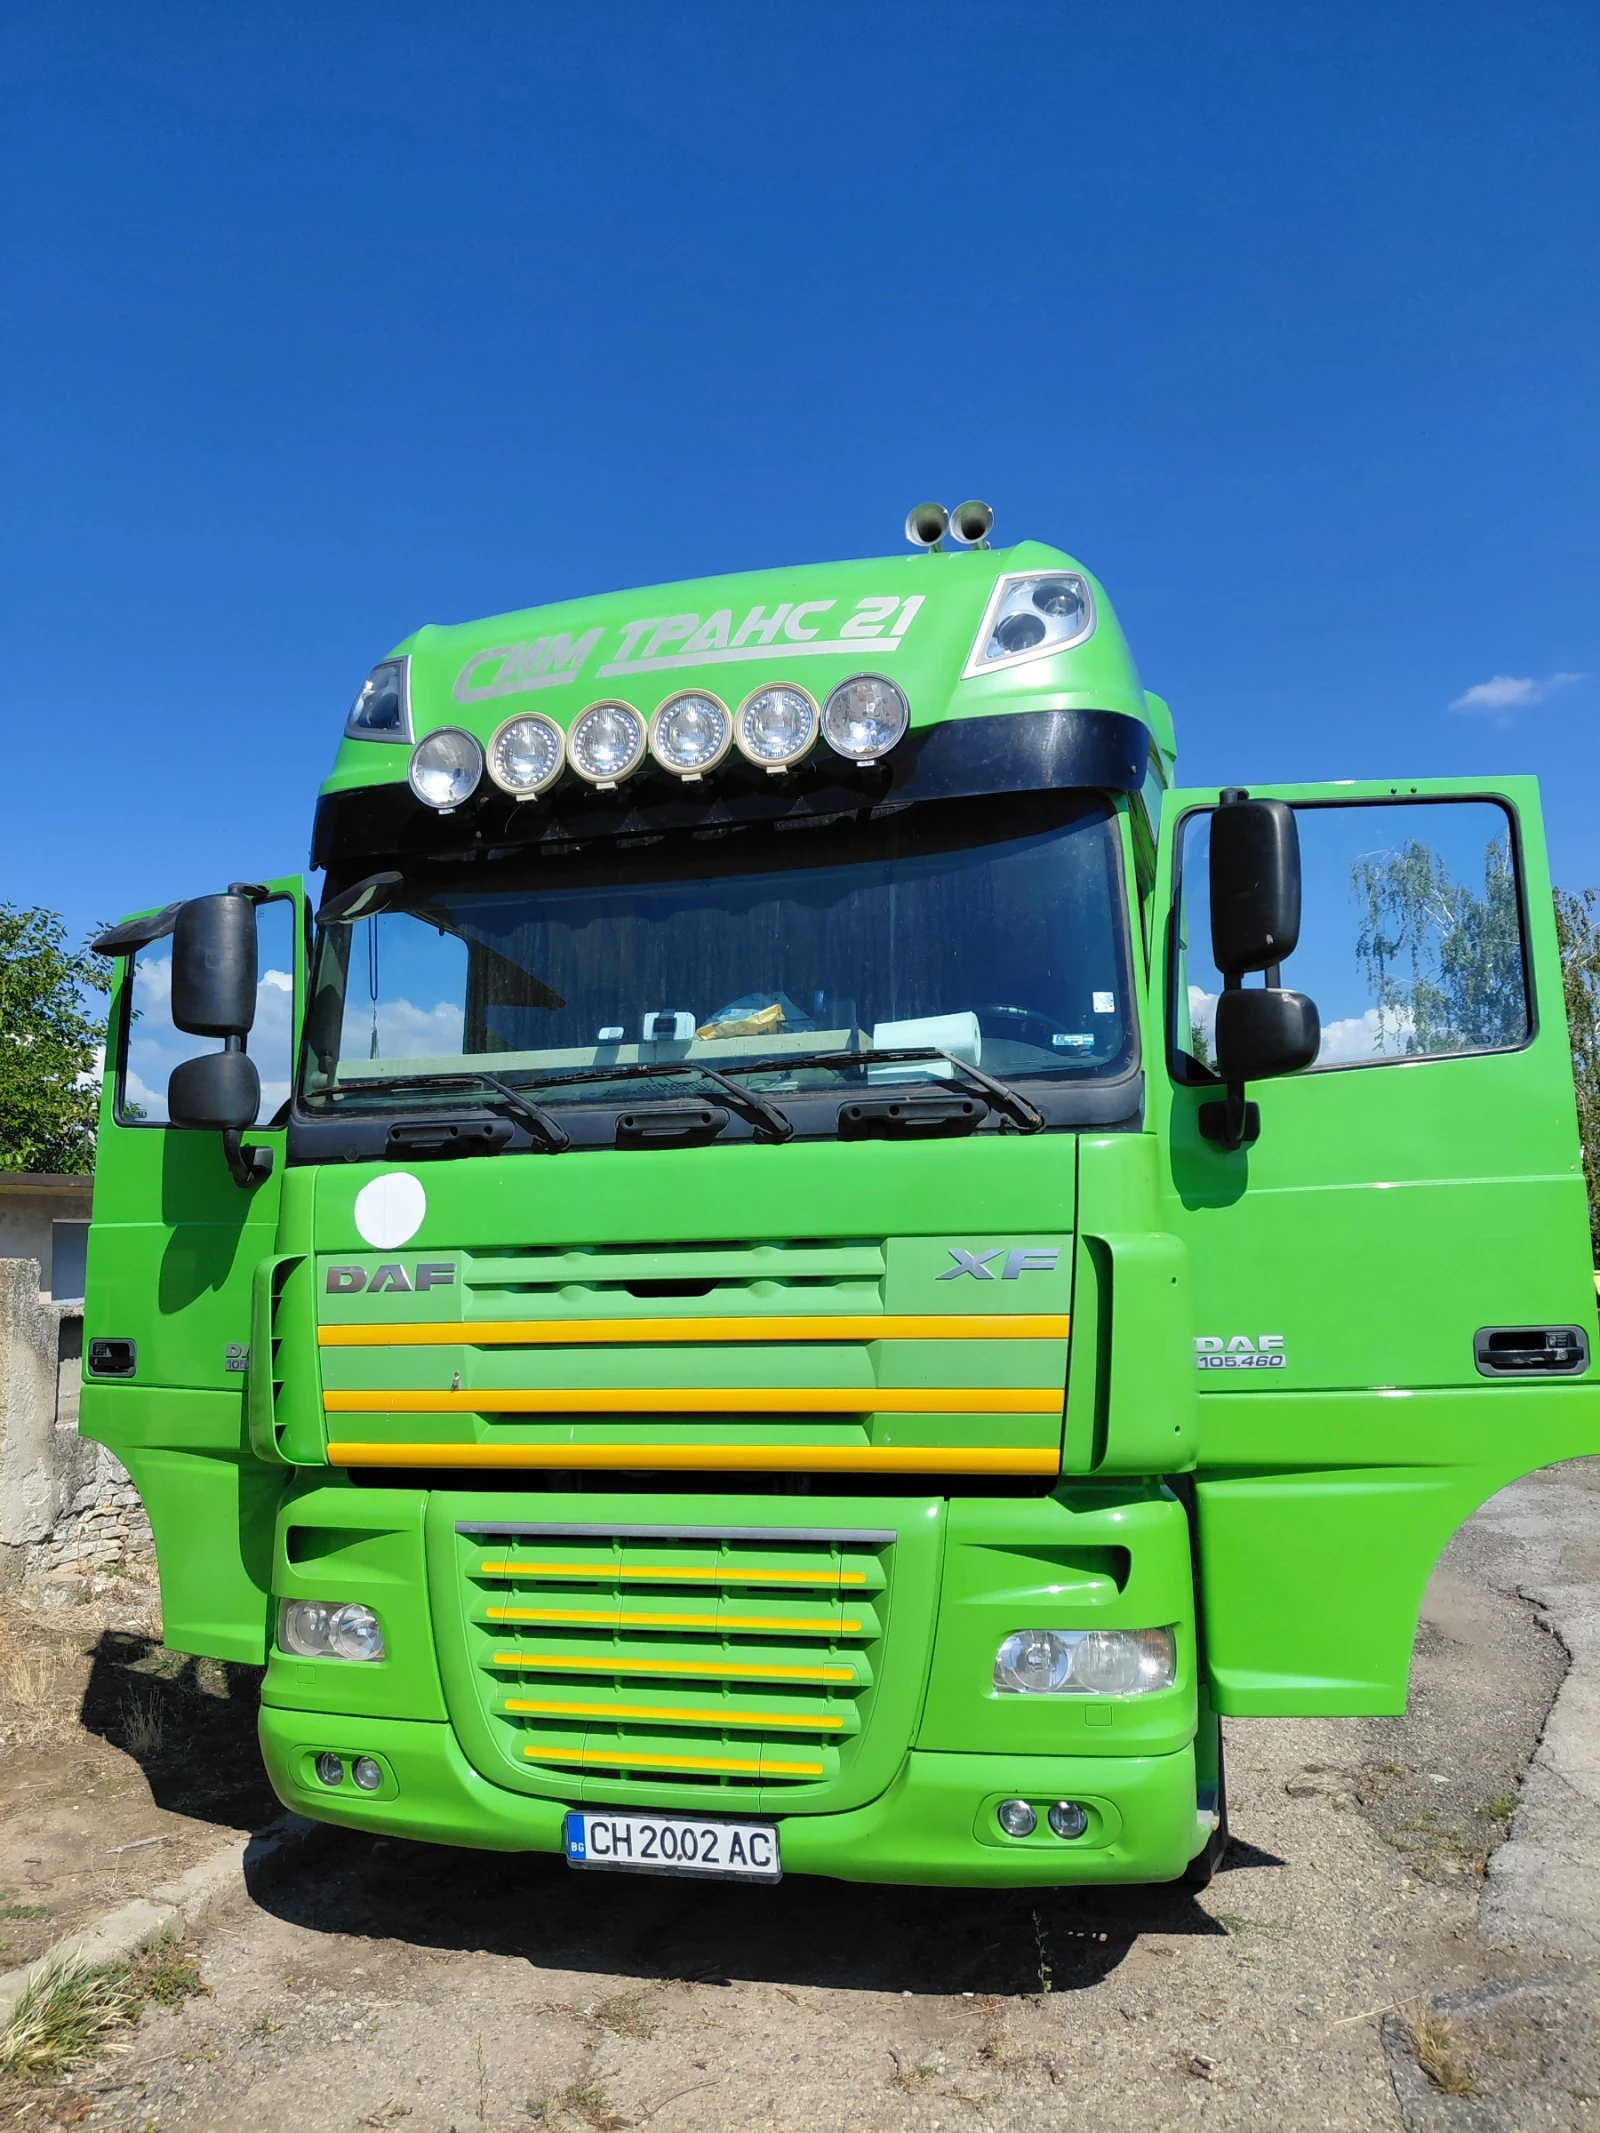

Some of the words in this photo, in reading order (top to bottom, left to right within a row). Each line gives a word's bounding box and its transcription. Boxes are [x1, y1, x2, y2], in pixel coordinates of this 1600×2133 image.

[453, 627, 603, 703] СИМ
[613, 600, 837, 660] ТРАНС
[840, 595, 926, 637] 21
[326, 1263, 455, 1294] DAF
[935, 1249, 1060, 1280] XF
[1193, 1335, 1284, 1353] DAF
[1198, 1355, 1283, 1368] 105.460
[571, 1841, 585, 1853] BG
[639, 1825, 719, 1864] 2002
